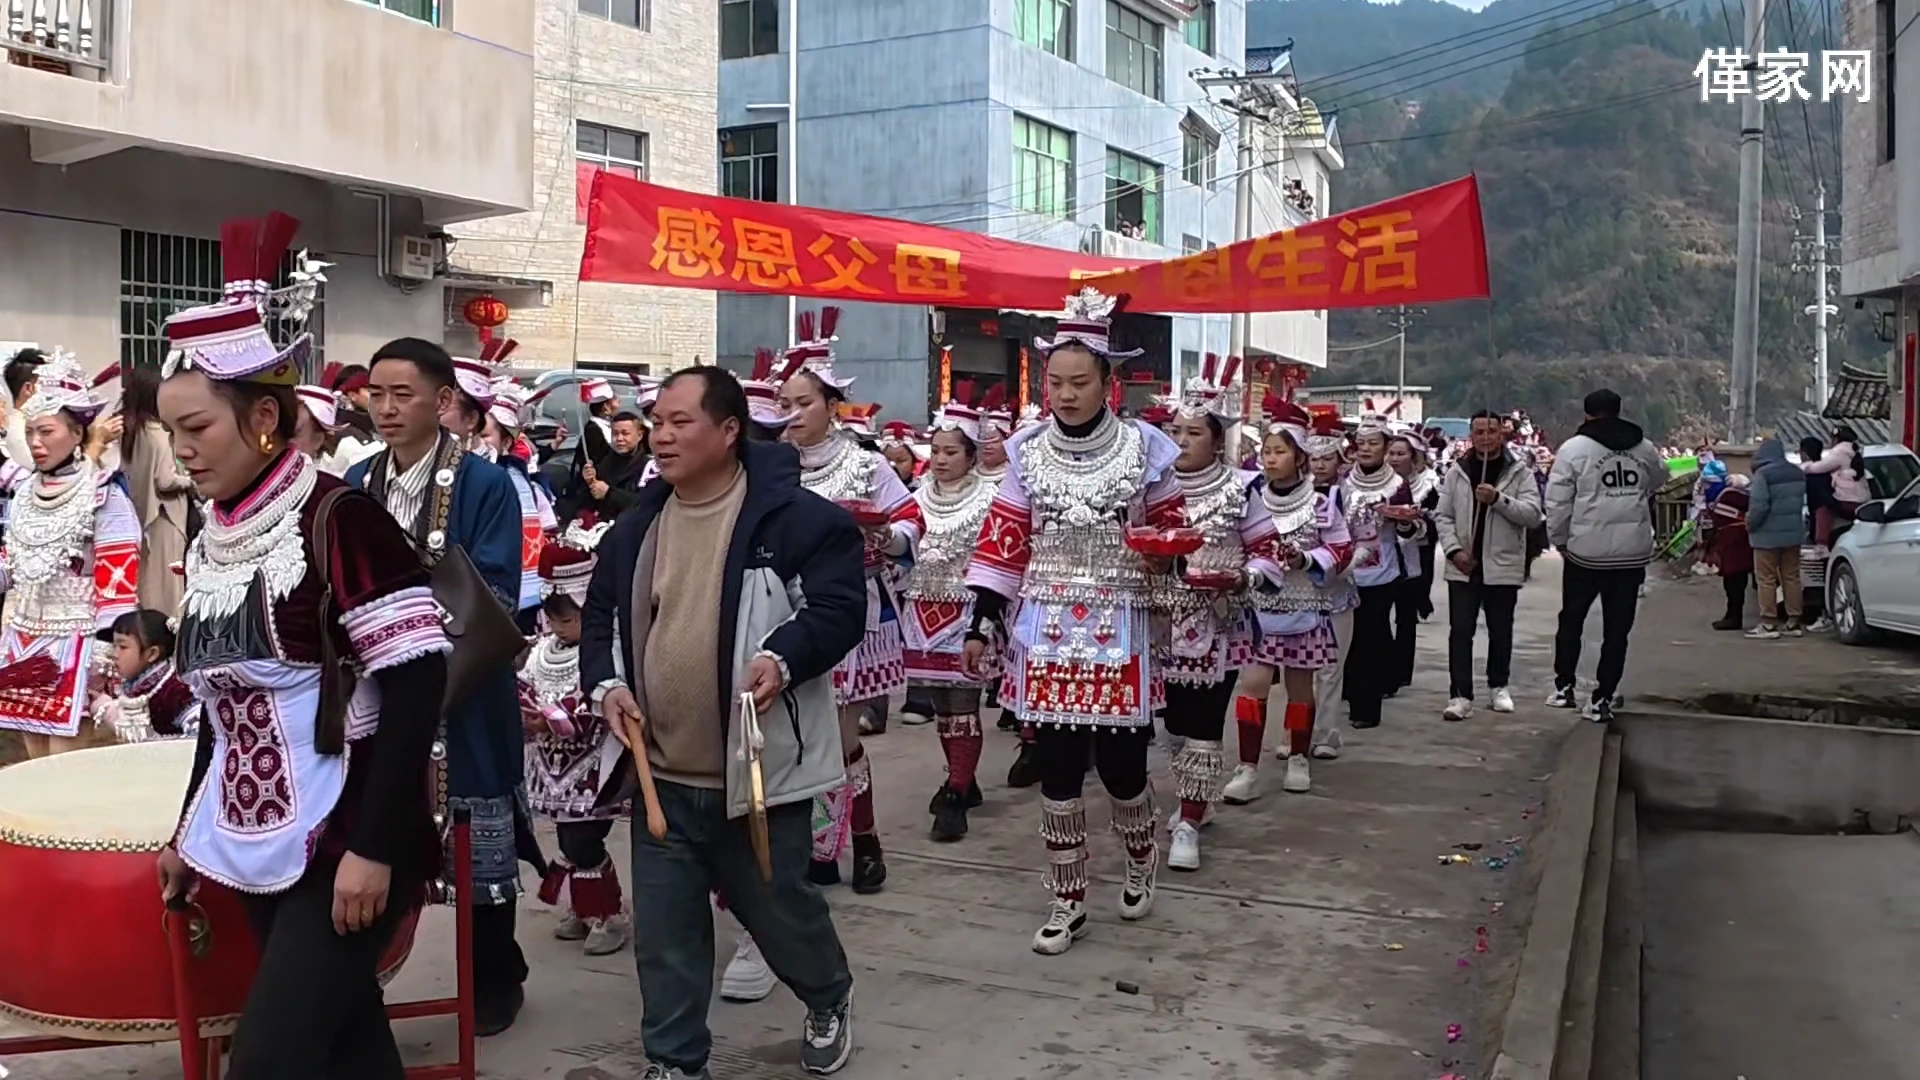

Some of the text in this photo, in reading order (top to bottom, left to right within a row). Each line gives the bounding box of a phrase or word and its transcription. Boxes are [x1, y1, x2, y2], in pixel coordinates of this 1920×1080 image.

[649, 206, 1419, 298] 感恩父母 恩生活
